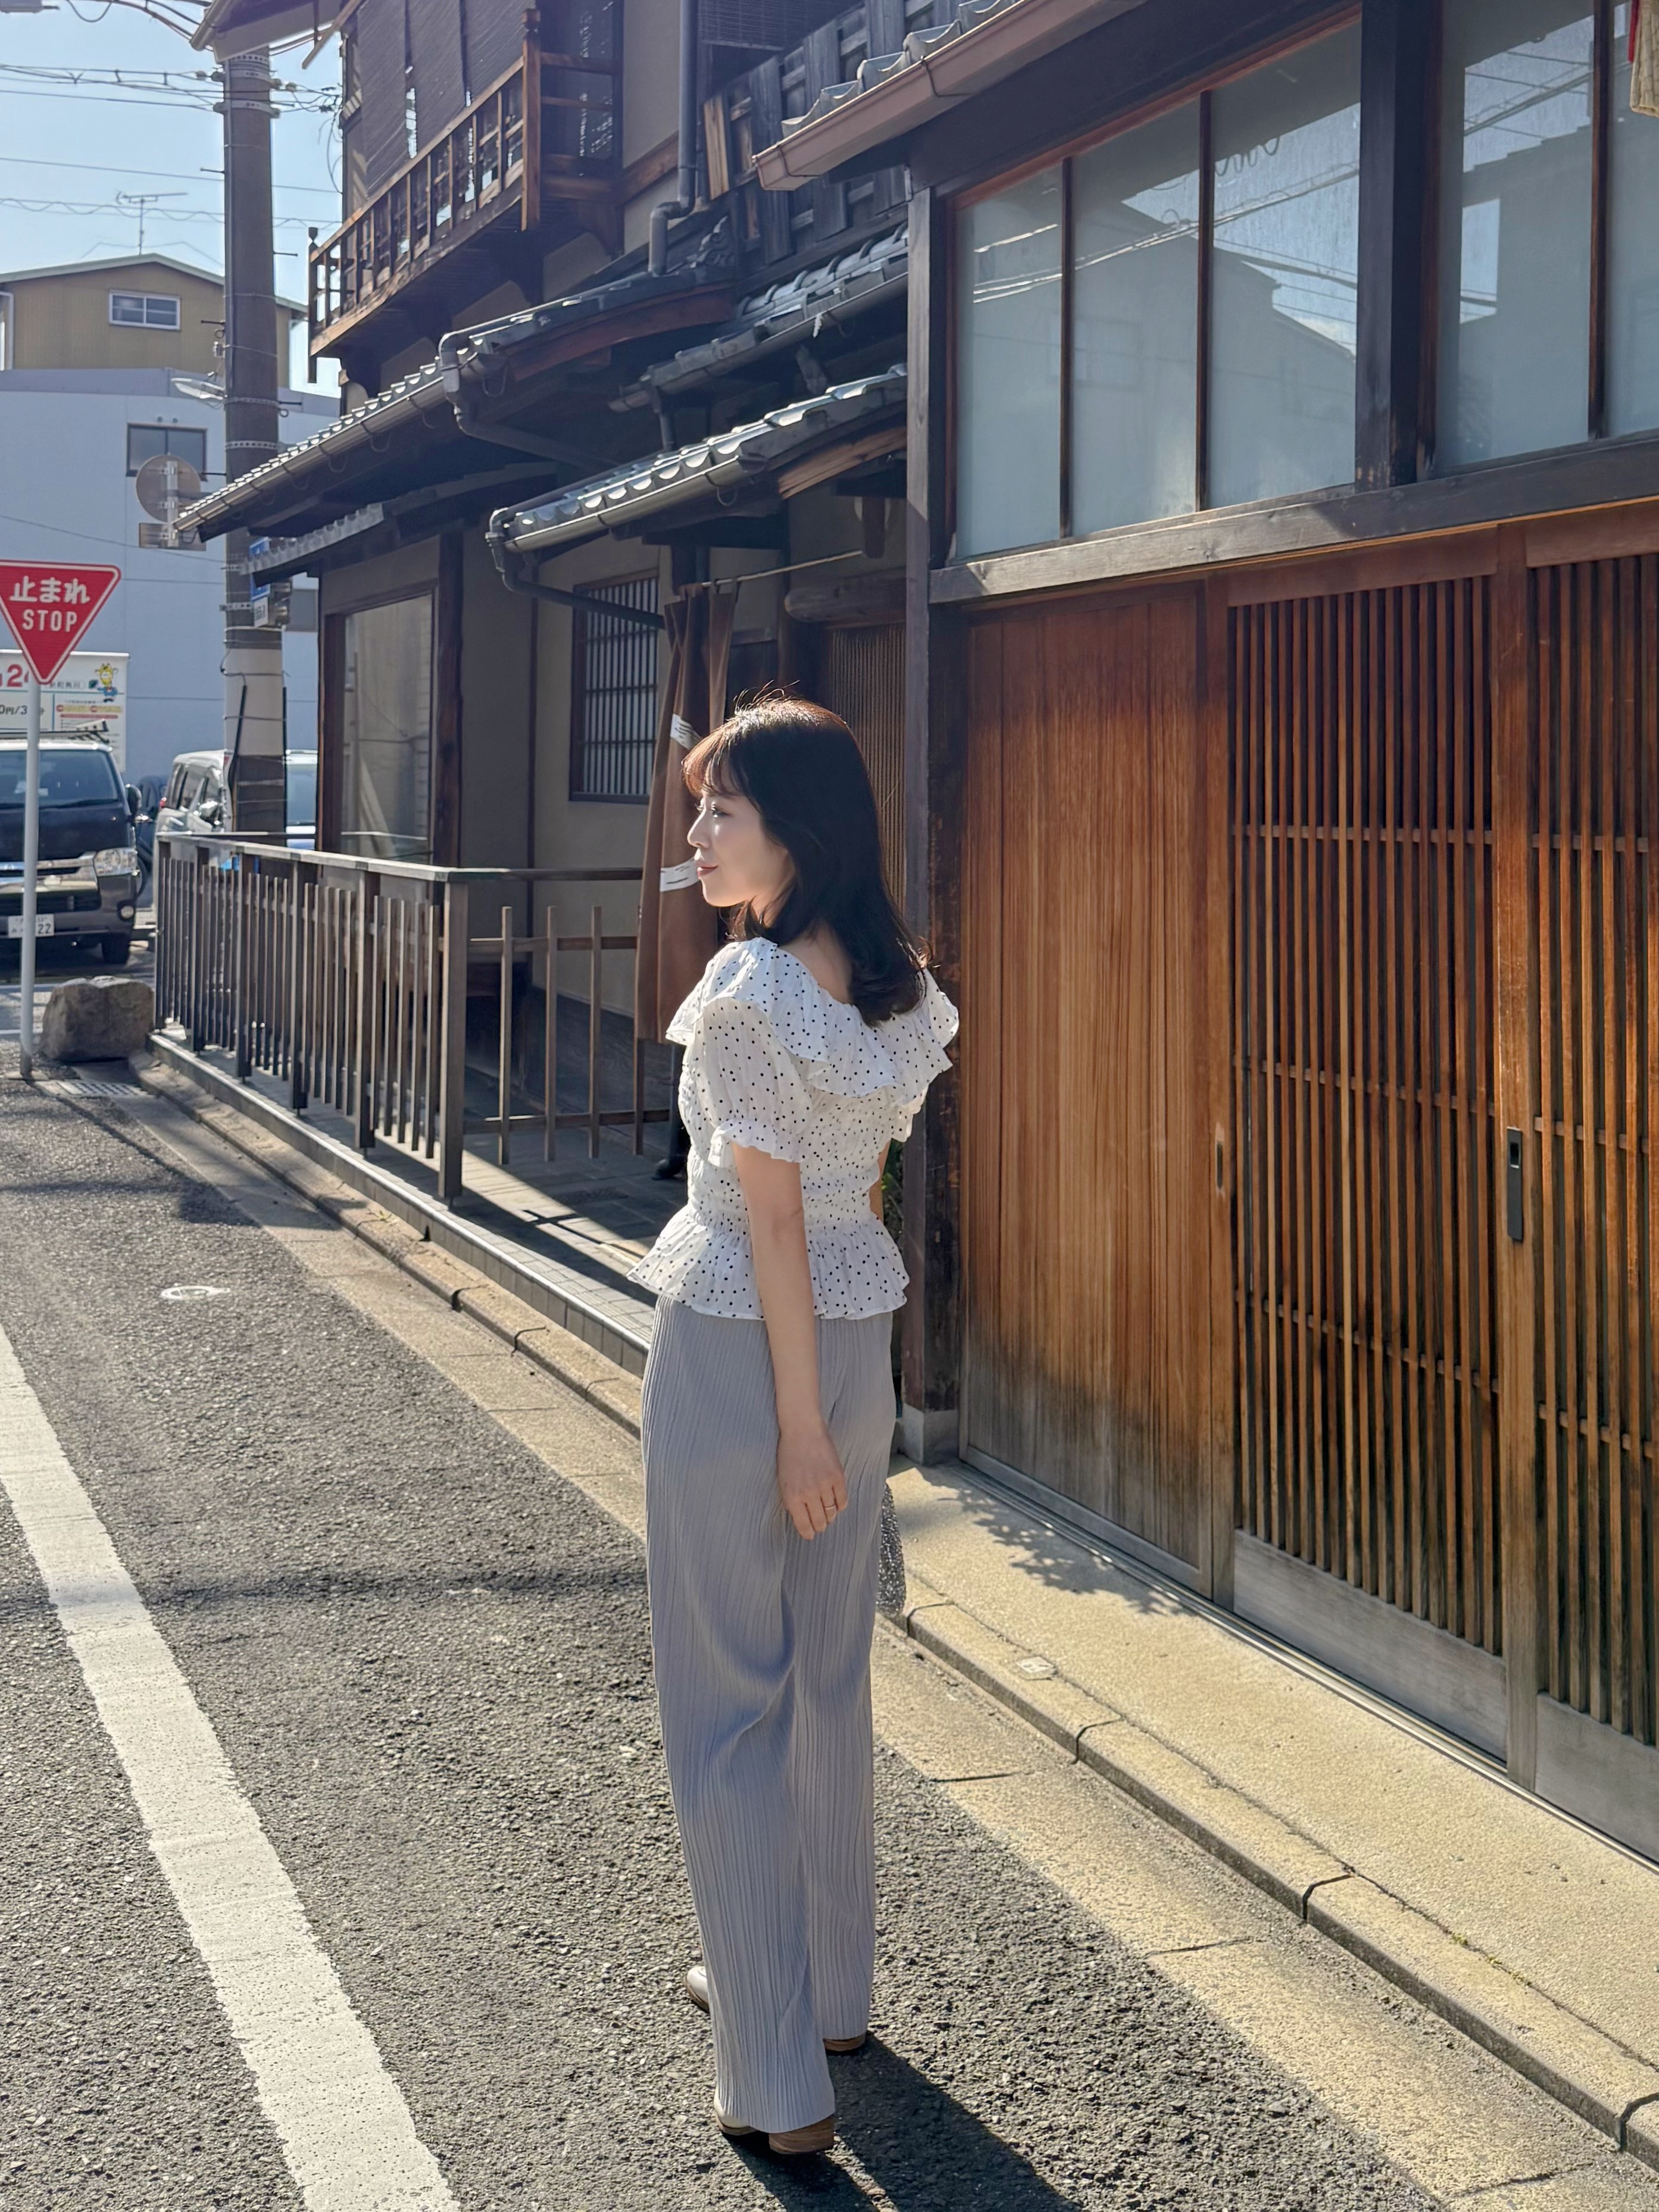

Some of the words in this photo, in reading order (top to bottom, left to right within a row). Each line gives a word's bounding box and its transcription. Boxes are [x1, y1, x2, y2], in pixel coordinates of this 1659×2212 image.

[10, 576, 90, 604] 止まれ
[23, 609, 77, 632] STOP
